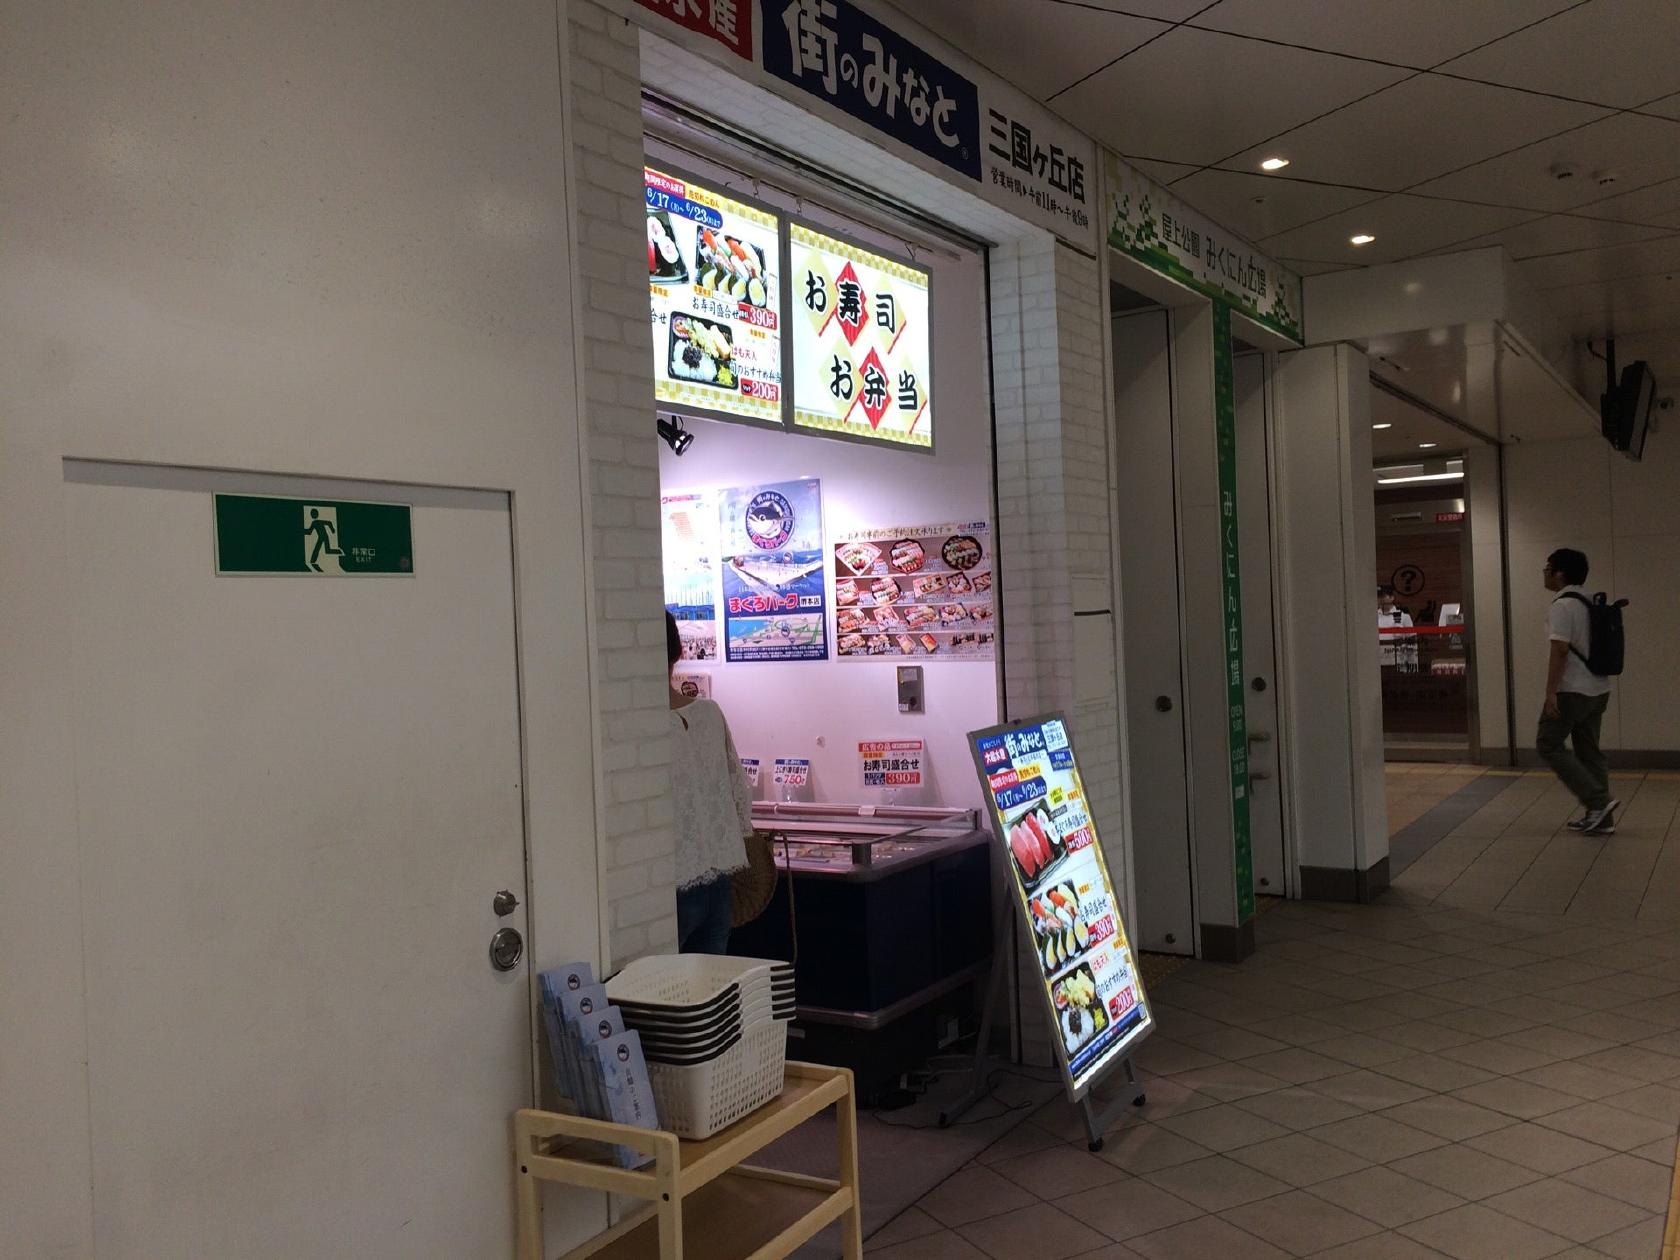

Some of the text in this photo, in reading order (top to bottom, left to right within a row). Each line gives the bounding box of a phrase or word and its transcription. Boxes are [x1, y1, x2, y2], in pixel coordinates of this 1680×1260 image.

[782, 0, 961, 148] 街のみなと
[989, 107, 1087, 205] 三国ヶ丘店
[1162, 213, 1267, 299] 屋上公園 みくにん広場
[804, 270, 895, 333] お寿司
[829, 354, 918, 411] お弁当
[352, 547, 376, 556] 非常口
[729, 592, 798, 613] まぐろパーク
[864, 758, 920, 772] お寿司盛合せ
